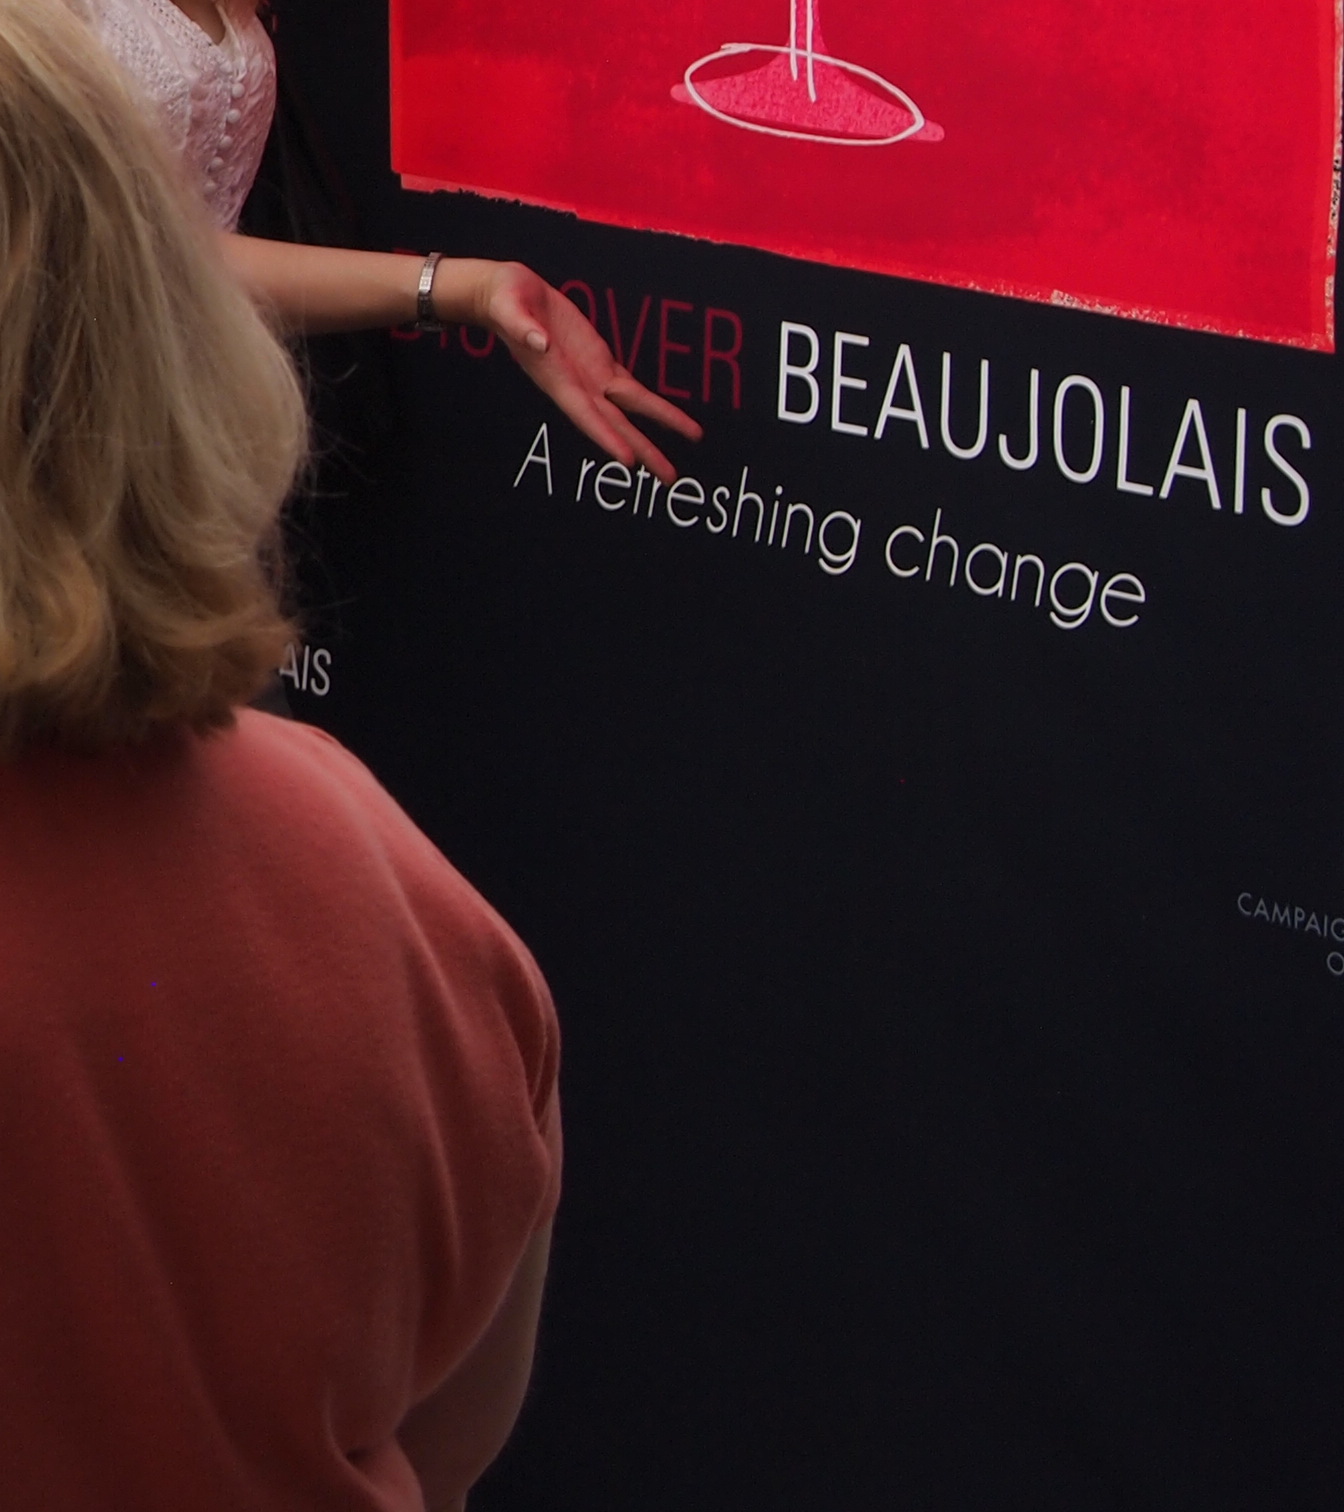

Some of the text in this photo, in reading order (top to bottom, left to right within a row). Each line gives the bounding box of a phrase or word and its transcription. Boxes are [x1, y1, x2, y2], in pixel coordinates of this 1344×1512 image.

[513, 422, 552, 495] A
[885, 507, 1146, 628] change
[776, 320, 1312, 526] BEAUJOLAIS
